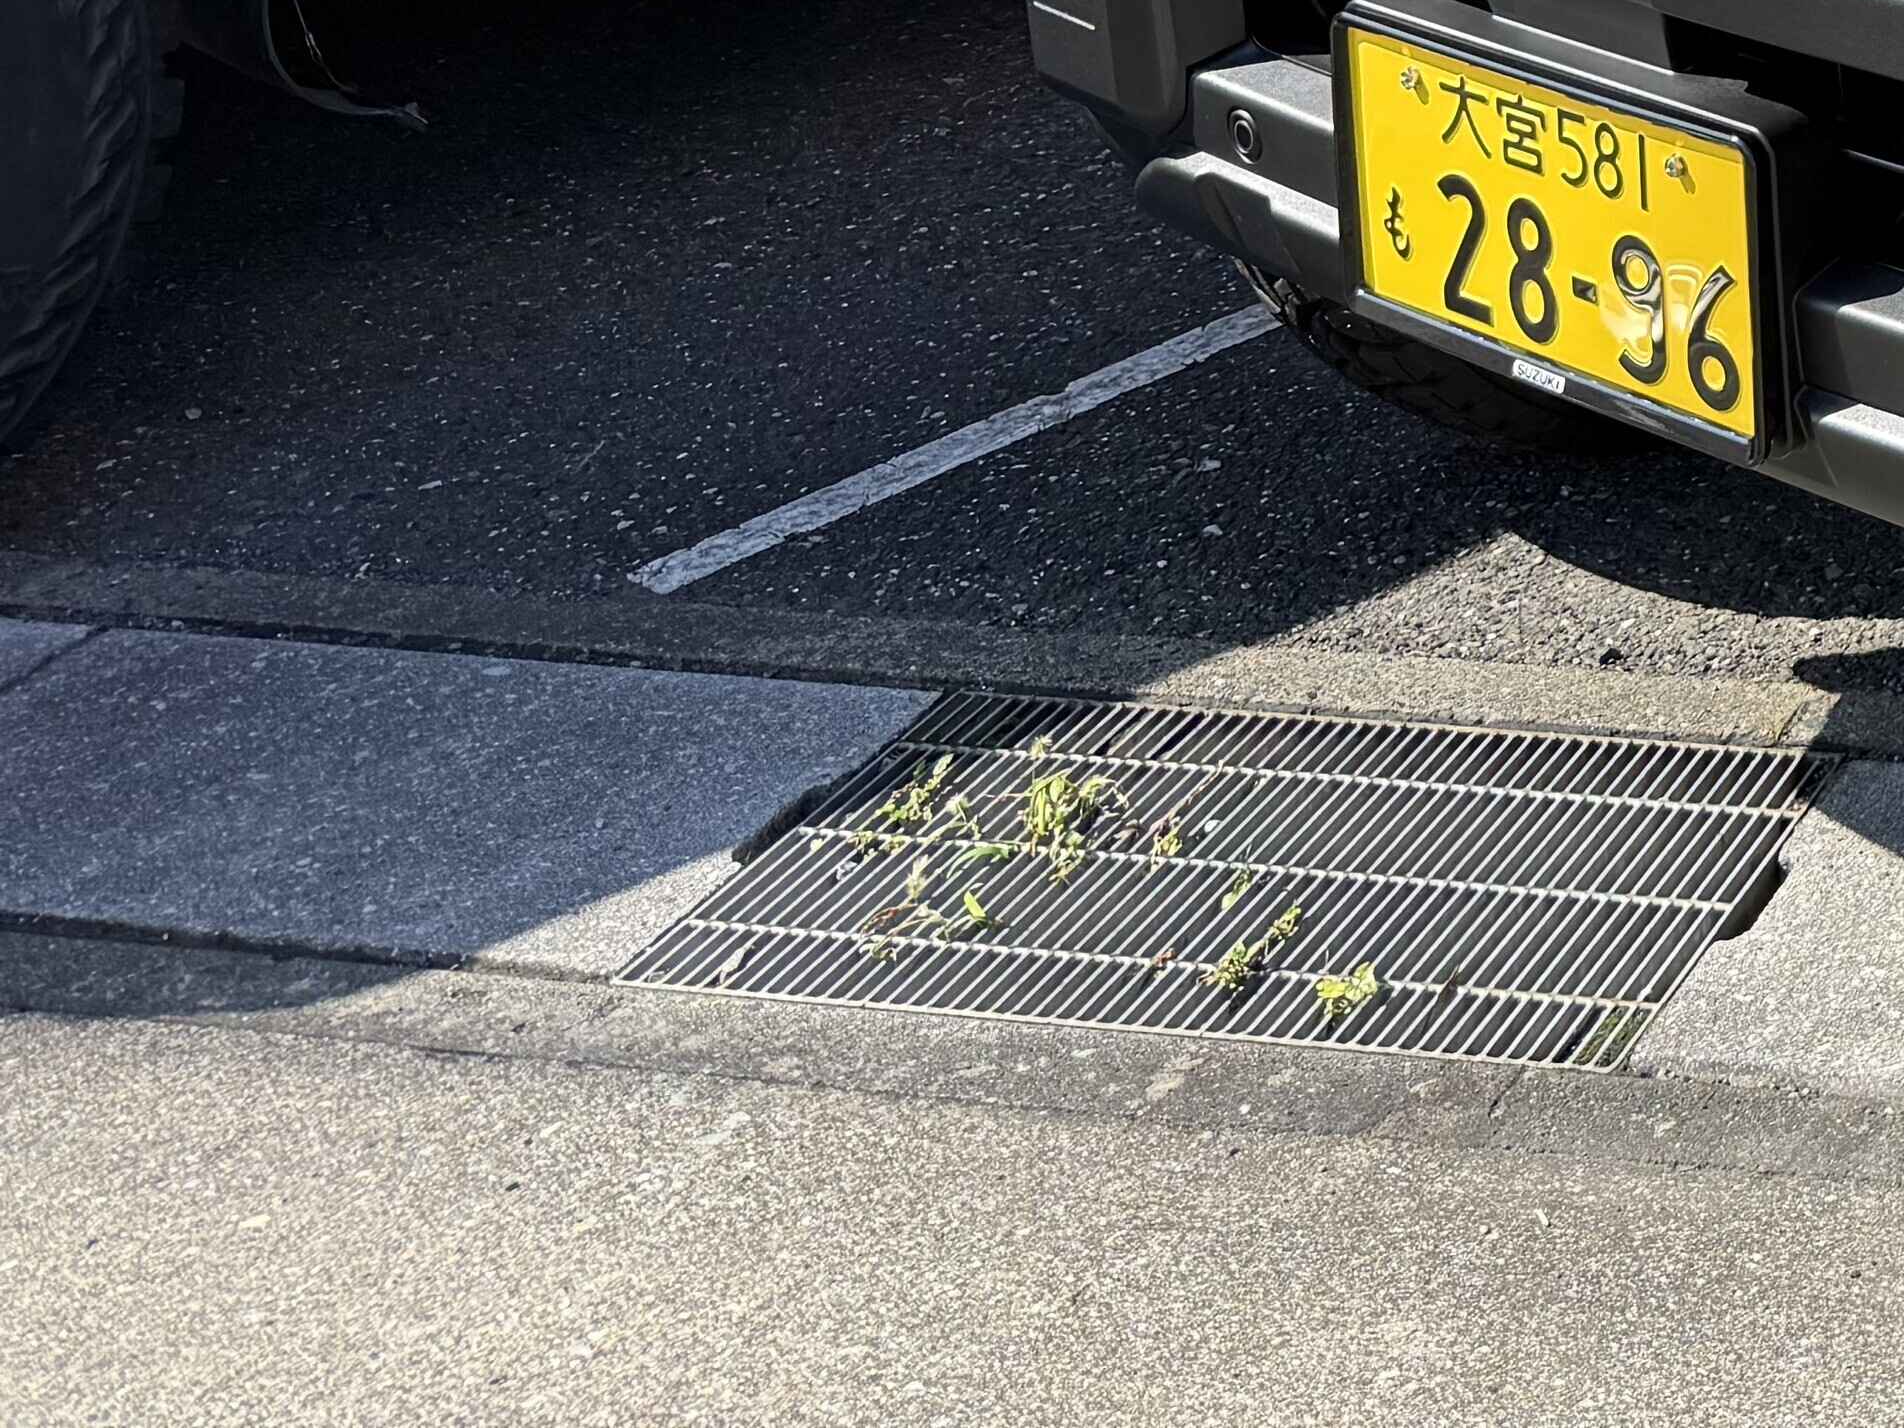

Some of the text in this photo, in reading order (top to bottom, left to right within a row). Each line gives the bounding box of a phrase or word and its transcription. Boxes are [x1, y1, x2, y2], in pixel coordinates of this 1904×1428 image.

[1438, 74, 1650, 212] 大宮581
[1383, 173, 1742, 412] も 28-96
[1515, 362, 1562, 392] SUZUKI
